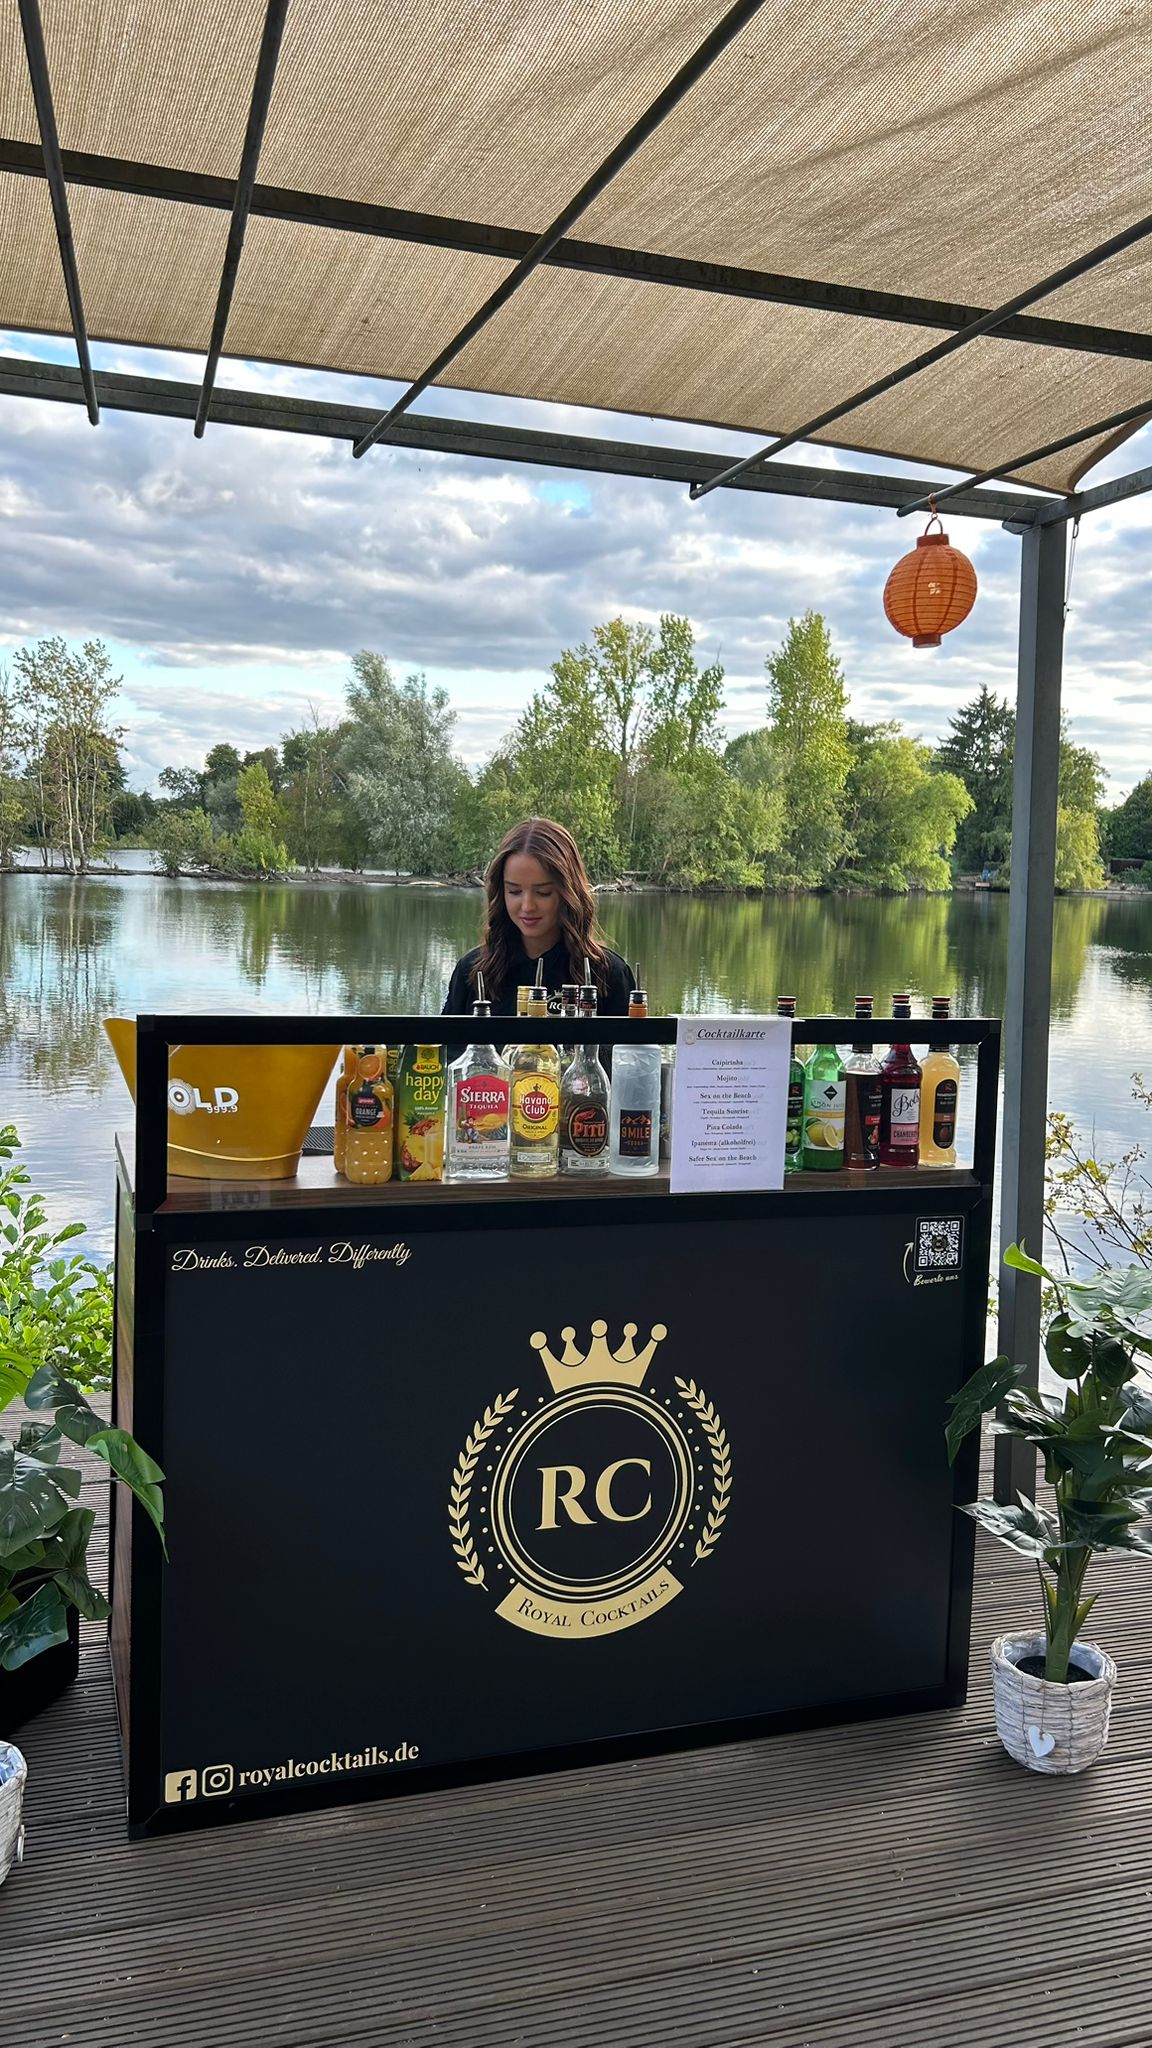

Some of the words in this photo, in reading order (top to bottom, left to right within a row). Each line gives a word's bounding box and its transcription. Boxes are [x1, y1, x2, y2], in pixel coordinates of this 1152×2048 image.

[697, 1028, 766, 1039] Cocktailkarte
[711, 1059, 743, 1067] Caipirinha
[405, 1072, 445, 1090] happy
[168, 1085, 239, 1109] OLD
[413, 1087, 440, 1104] day
[460, 1087, 505, 1104] SIERRA
[519, 1094, 553, 1105] Havana
[206, 1104, 238, 1113] 999.9
[525, 1105, 546, 1115] Club
[691, 1140, 717, 1148] Ipanema
[718, 1139, 757, 1147] (alkoholfrei)
[171, 1248, 238, 1271] Drinks.
[243, 1245, 323, 1267] Delivered.
[328, 1241, 412, 1269] Differently
[535, 1457, 653, 1531] RC
[239, 1742, 420, 1787] royalcocktails.de
